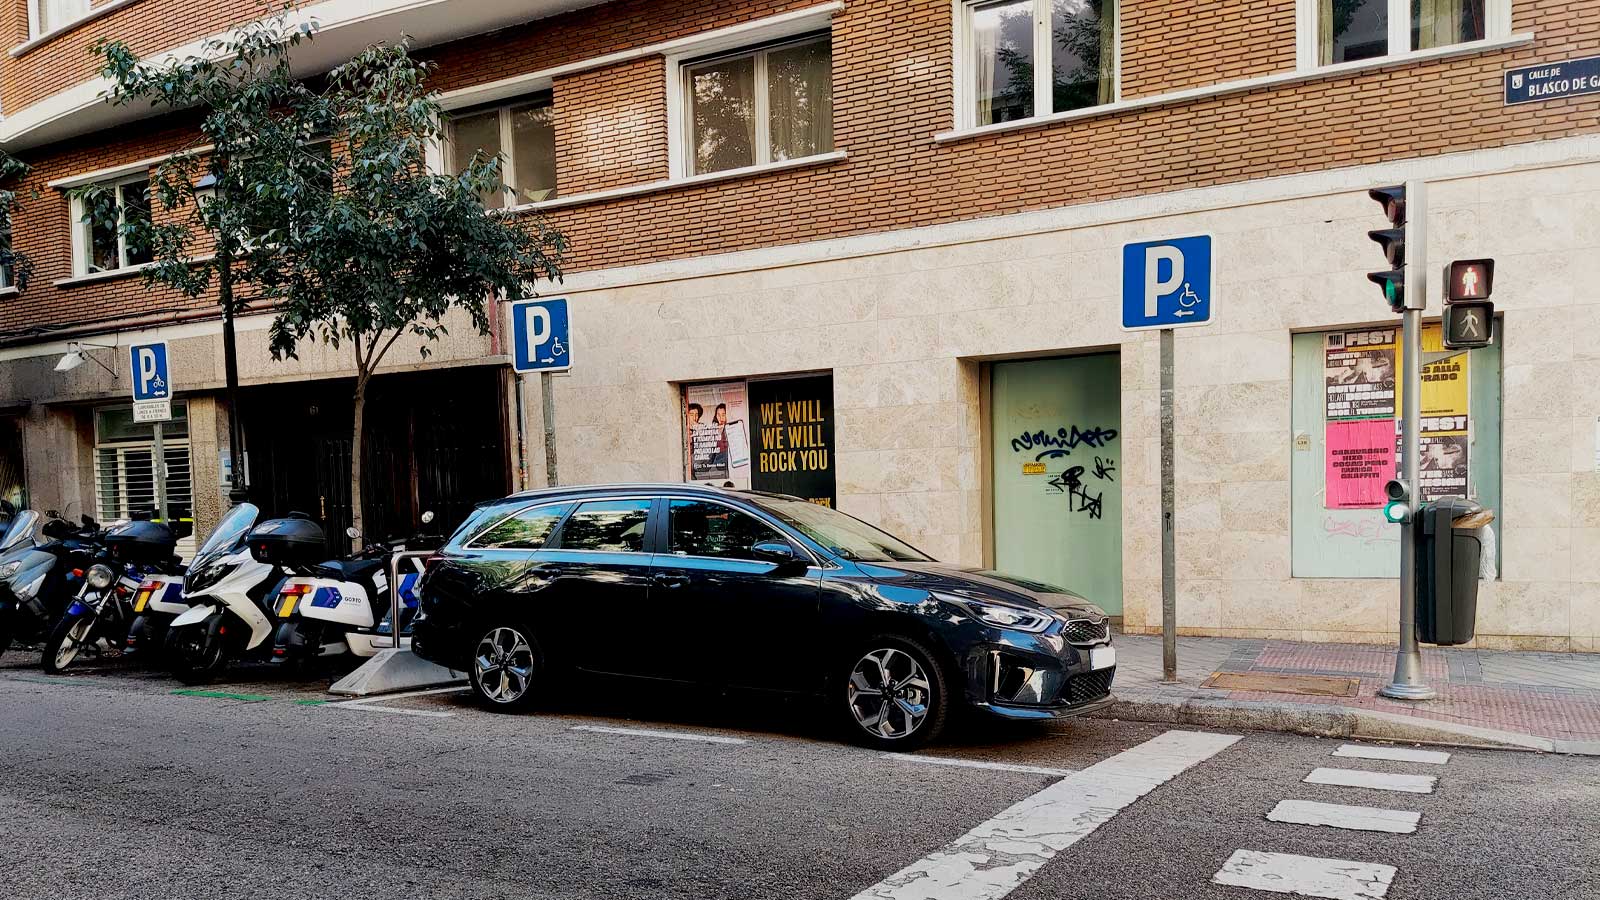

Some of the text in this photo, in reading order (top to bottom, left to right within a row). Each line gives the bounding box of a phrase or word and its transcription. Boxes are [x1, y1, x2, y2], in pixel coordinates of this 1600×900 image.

[1529, 67, 1561, 79] CALLE DE
[1529, 80, 1569, 96] BLASCO
[1572, 77, 1587, 90] DE
[1144, 245, 1185, 317] P
[525, 305, 551, 362] P
[1346, 330, 1394, 346] FEST
[139, 348, 157, 394] P
[761, 400, 825, 425] WE WILL
[1420, 416, 1467, 431] FEST
[761, 425, 825, 450] WE WILL
[760, 449, 828, 473] ROCK YOU
